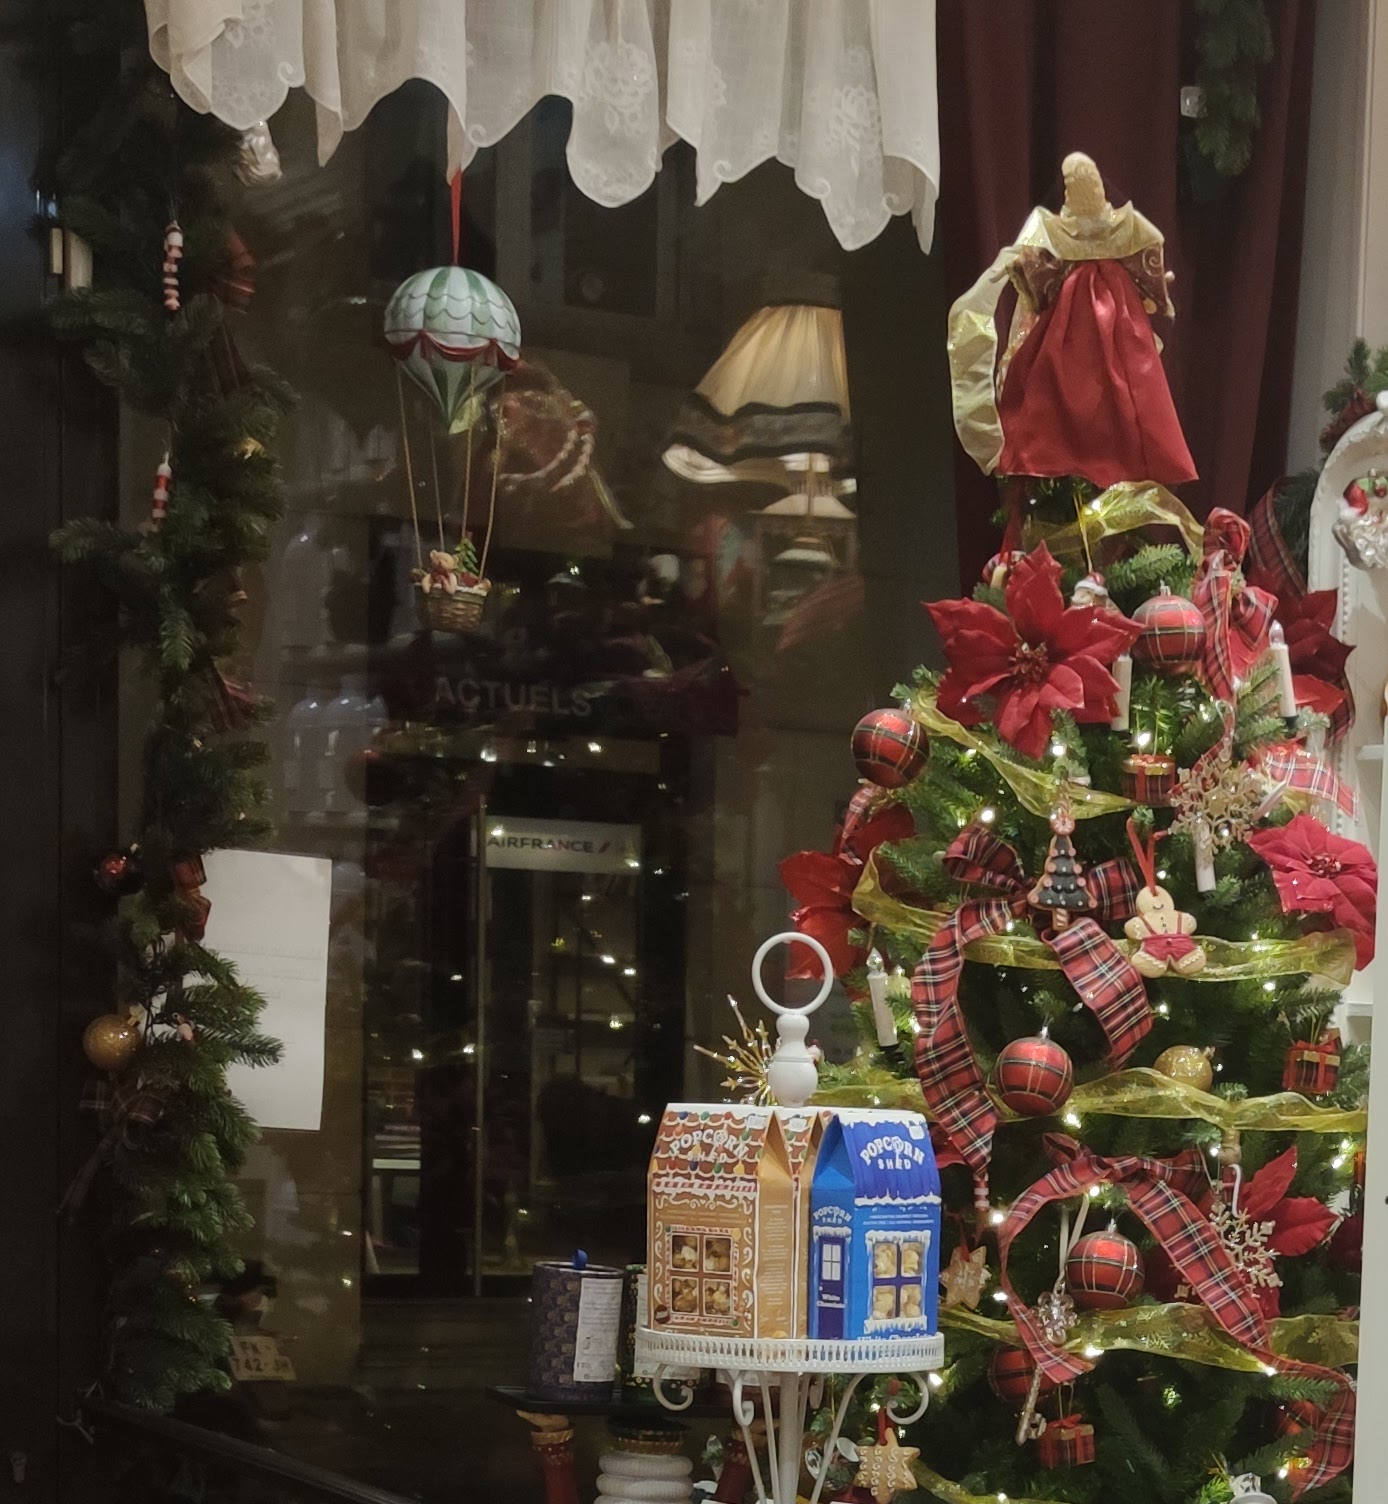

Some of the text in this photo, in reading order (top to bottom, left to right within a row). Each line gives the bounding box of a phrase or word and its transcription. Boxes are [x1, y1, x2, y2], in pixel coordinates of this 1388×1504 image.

[435, 677, 591, 716] ACTUELS
[669, 1129, 750, 1160] POPCORN
[860, 1136, 925, 1166] POPCORN
[687, 1151, 727, 1164] SHED
[878, 1157, 911, 1170] SHED
[813, 1206, 852, 1222] POPCORN
